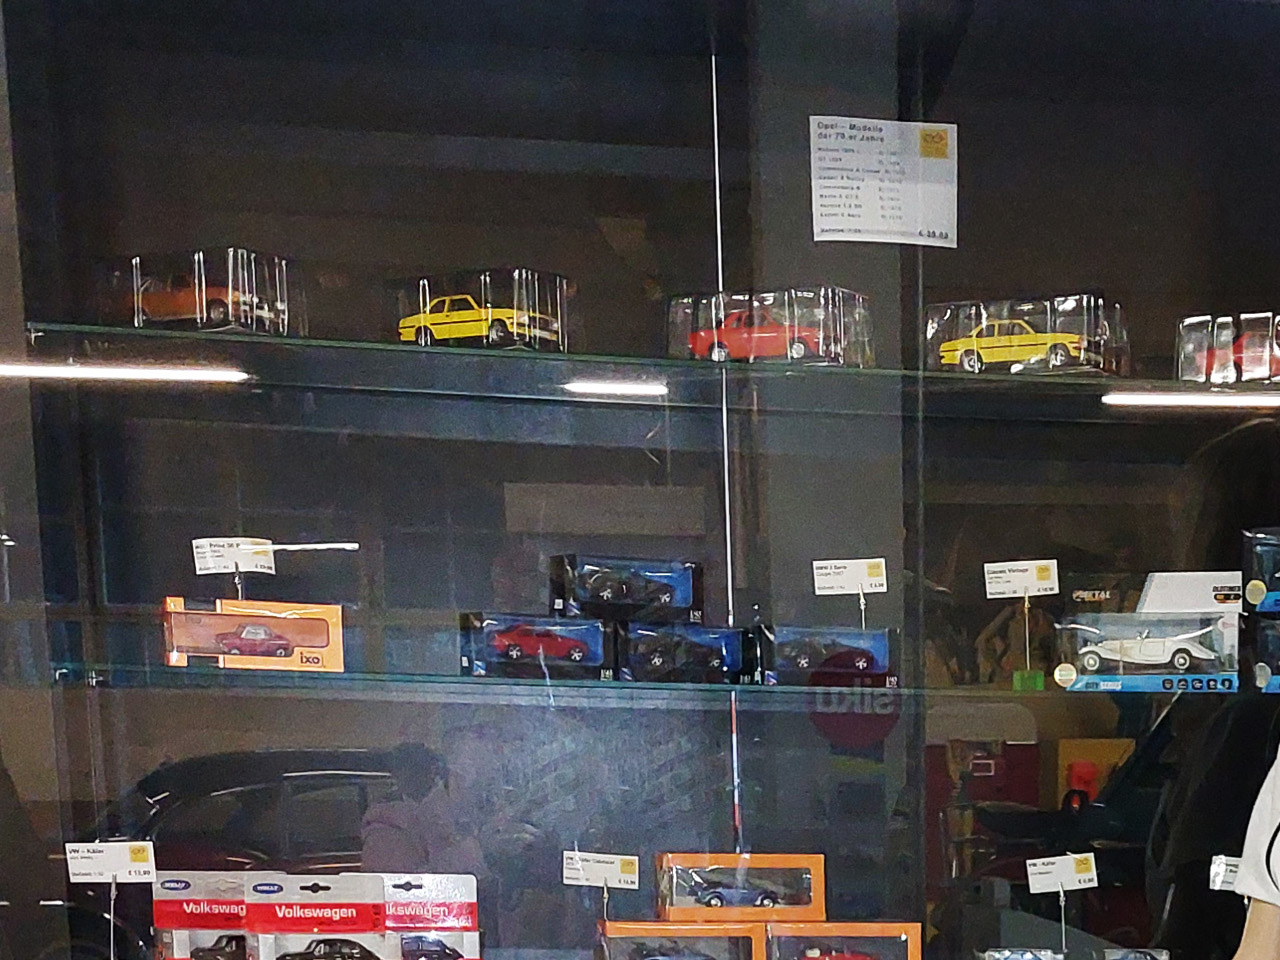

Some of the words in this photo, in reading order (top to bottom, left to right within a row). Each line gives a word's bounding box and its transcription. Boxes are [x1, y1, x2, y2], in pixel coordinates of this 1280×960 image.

[300, 651, 321, 664] ixo
[183, 902, 245, 915] Volkswag
[275, 905, 357, 919] Volkswagen
[386, 903, 449, 917] lkswagen
